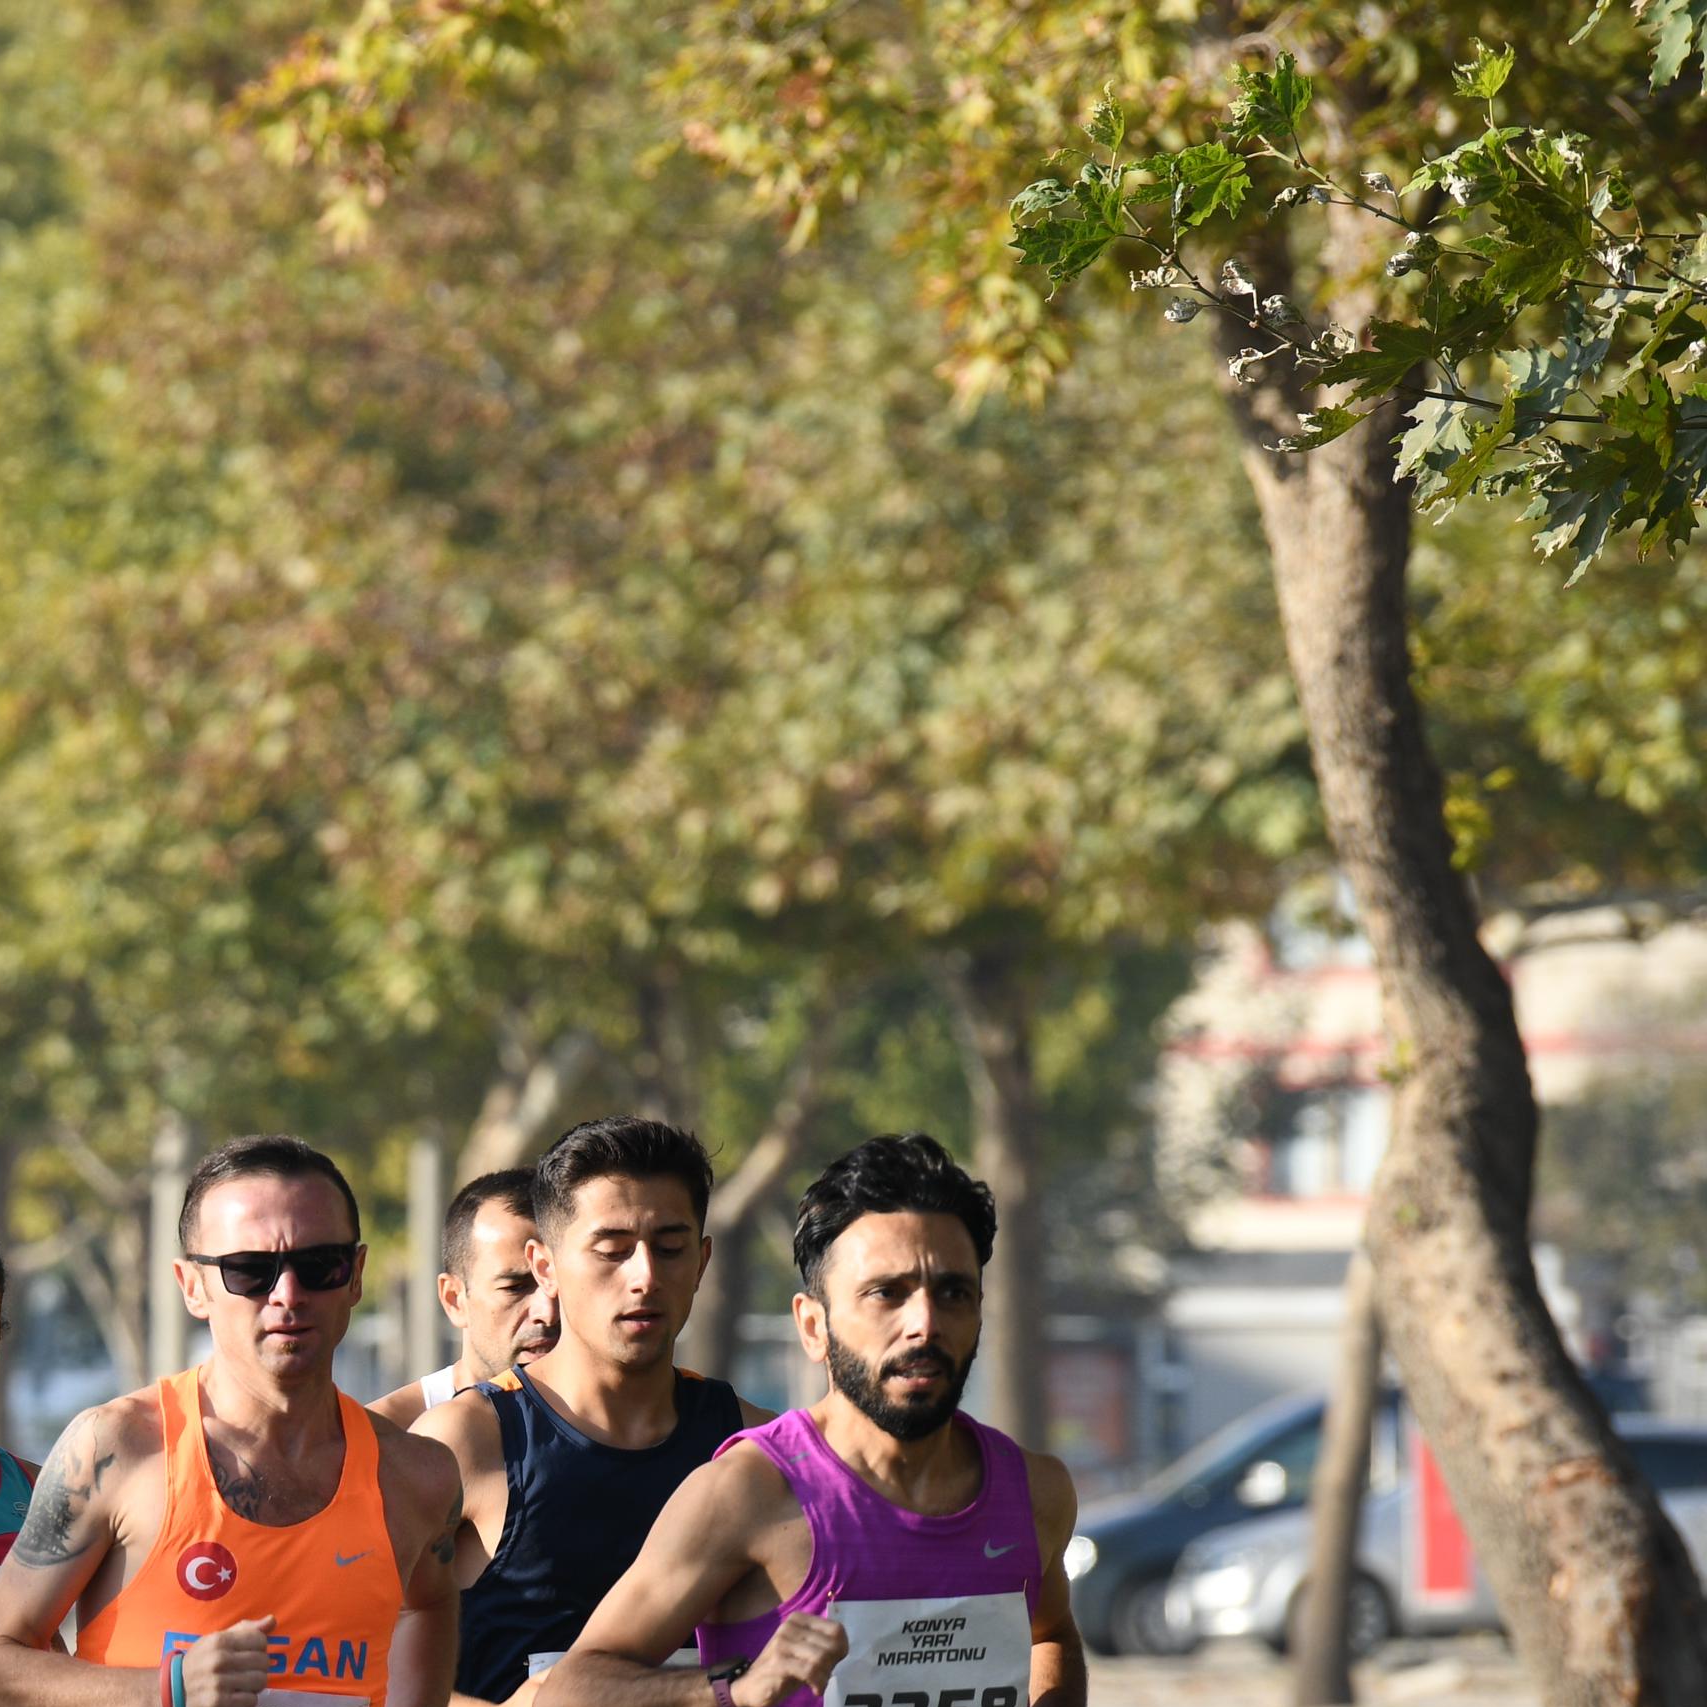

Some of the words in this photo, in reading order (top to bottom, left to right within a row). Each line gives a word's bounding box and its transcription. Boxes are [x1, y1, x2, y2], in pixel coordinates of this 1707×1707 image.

[902, 1617, 966, 1634] KONYA
[911, 1633, 954, 1649] YARI
[877, 1647, 987, 1666] MARATONU
